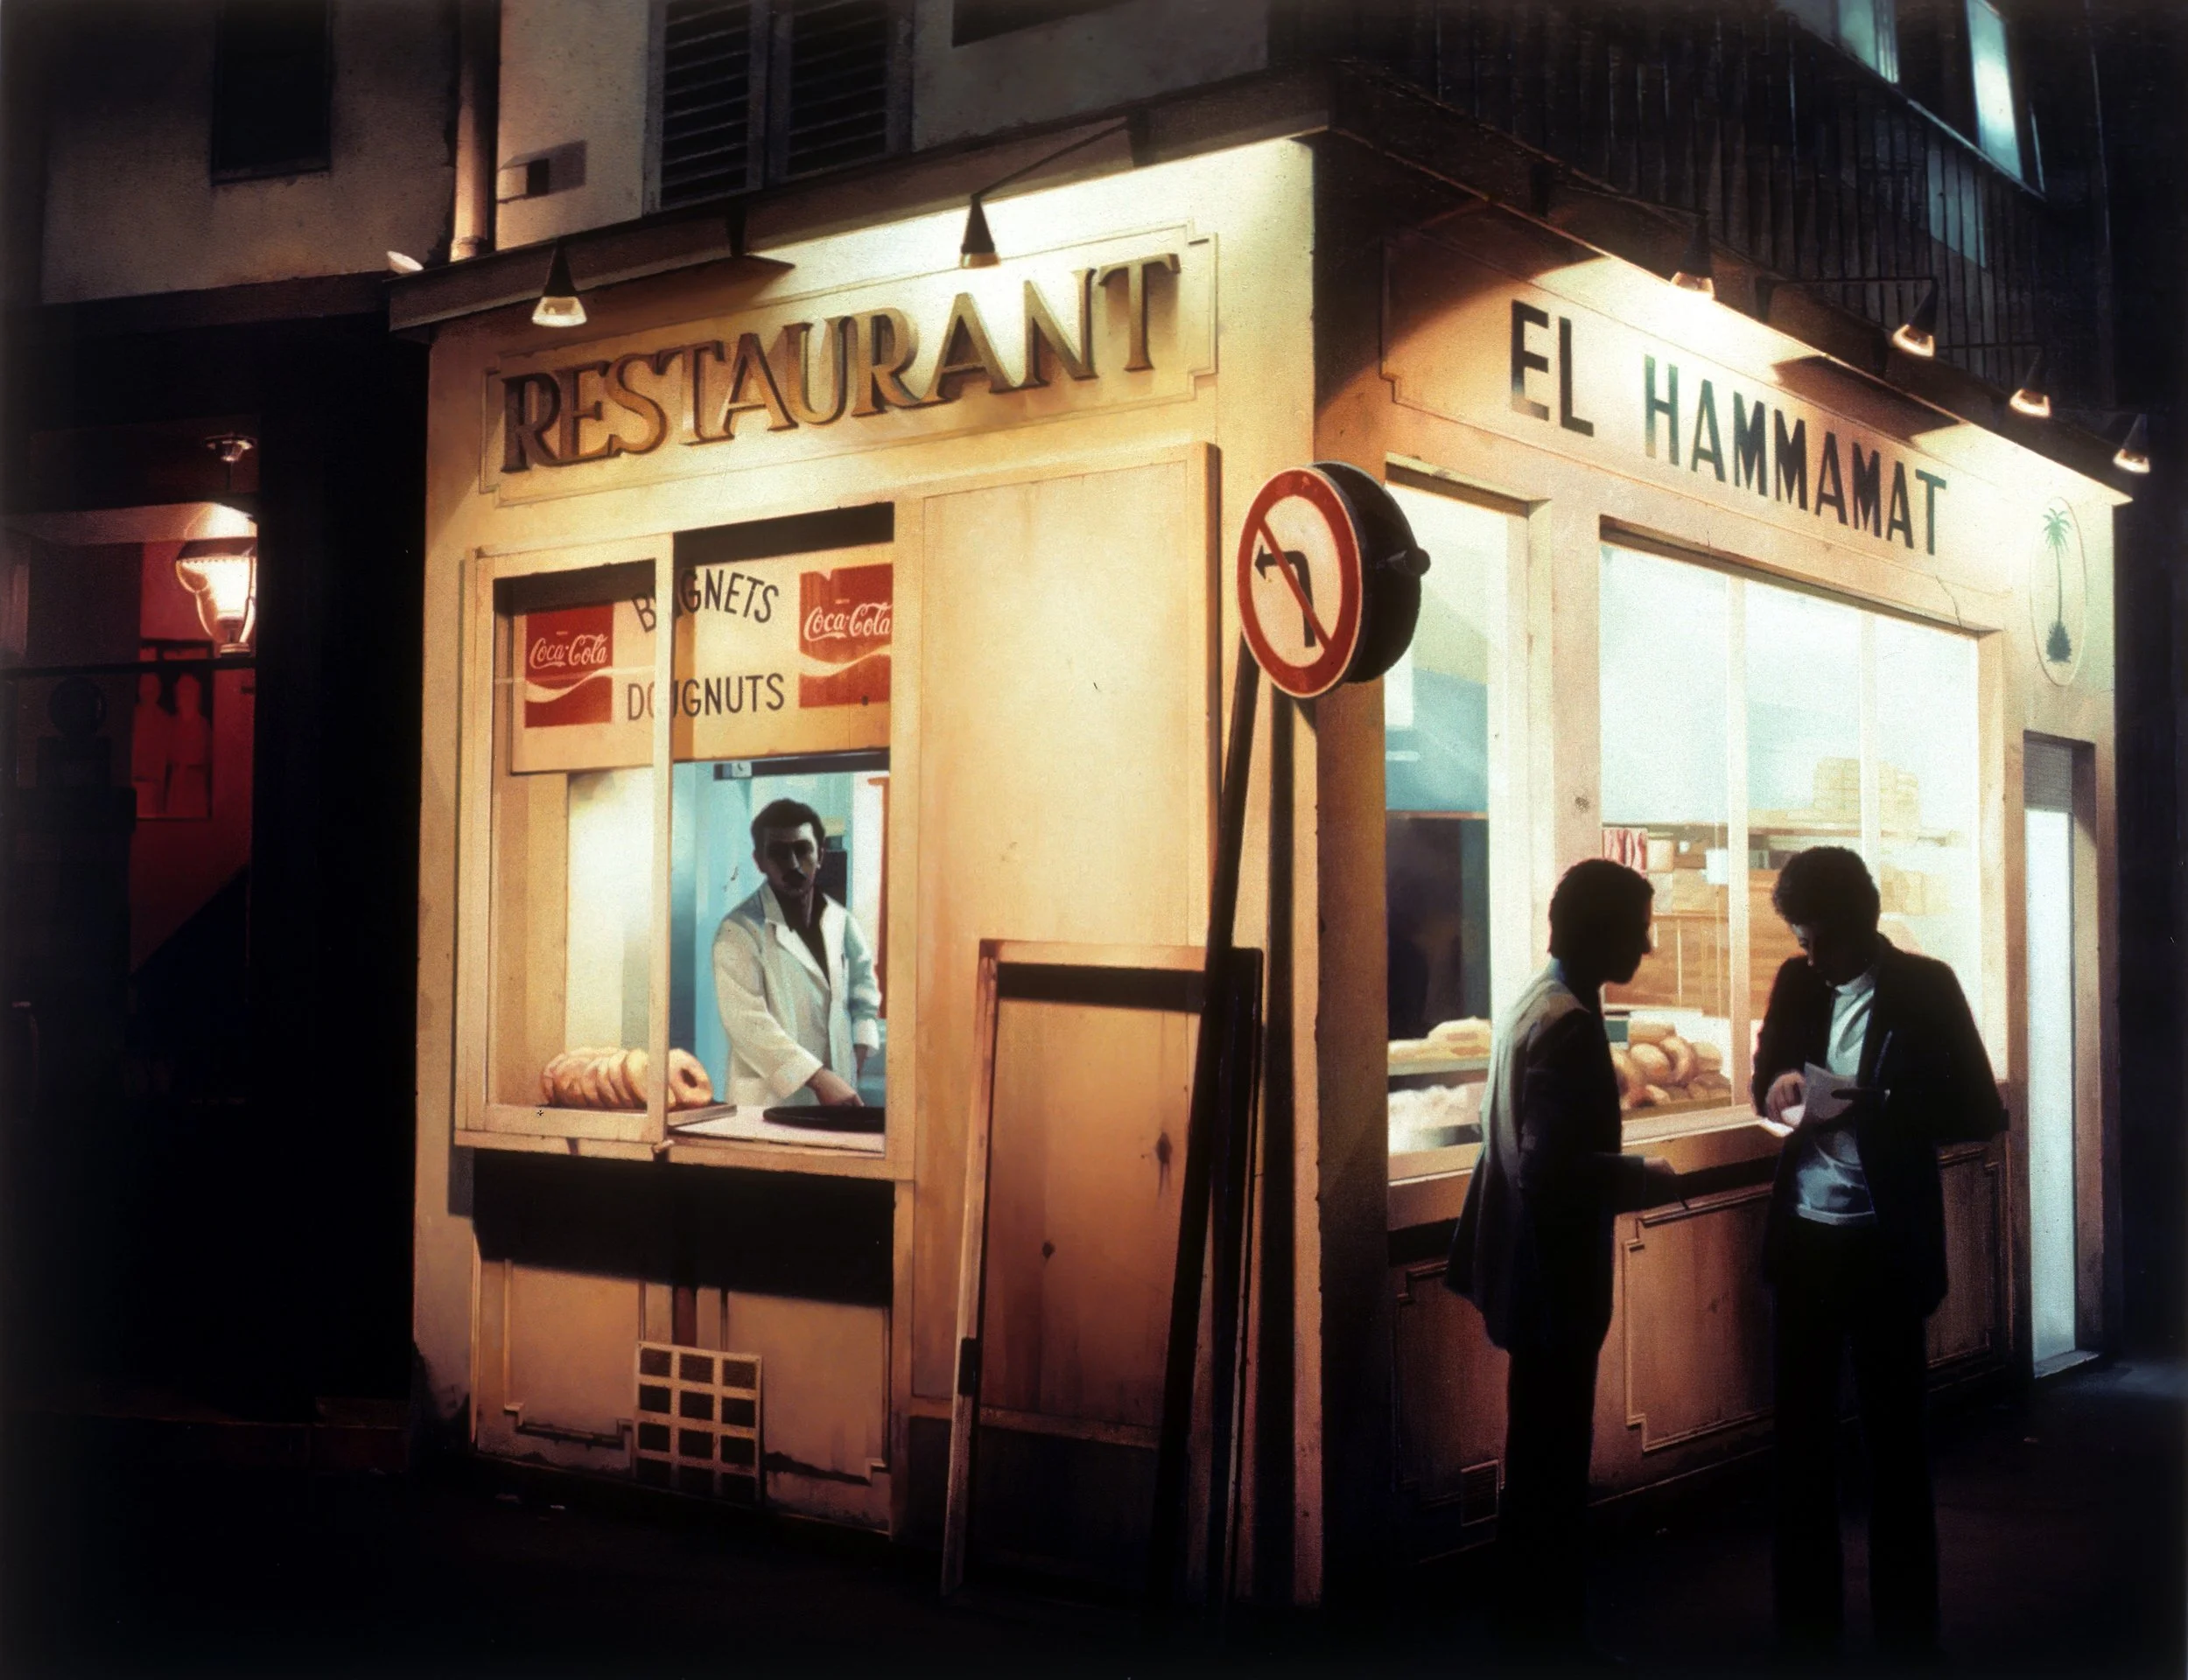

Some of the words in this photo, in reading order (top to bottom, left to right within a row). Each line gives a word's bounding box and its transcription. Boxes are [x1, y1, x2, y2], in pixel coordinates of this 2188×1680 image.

[500, 251, 1181, 474] RESTAURANT
[1511, 299, 1595, 437] EL
[1644, 354, 1947, 556] HAMMAMAT
[631, 568, 779, 634] BGNETS
[803, 602, 893, 641] Coca-Cola
[529, 634, 608, 669] Coca-Cola
